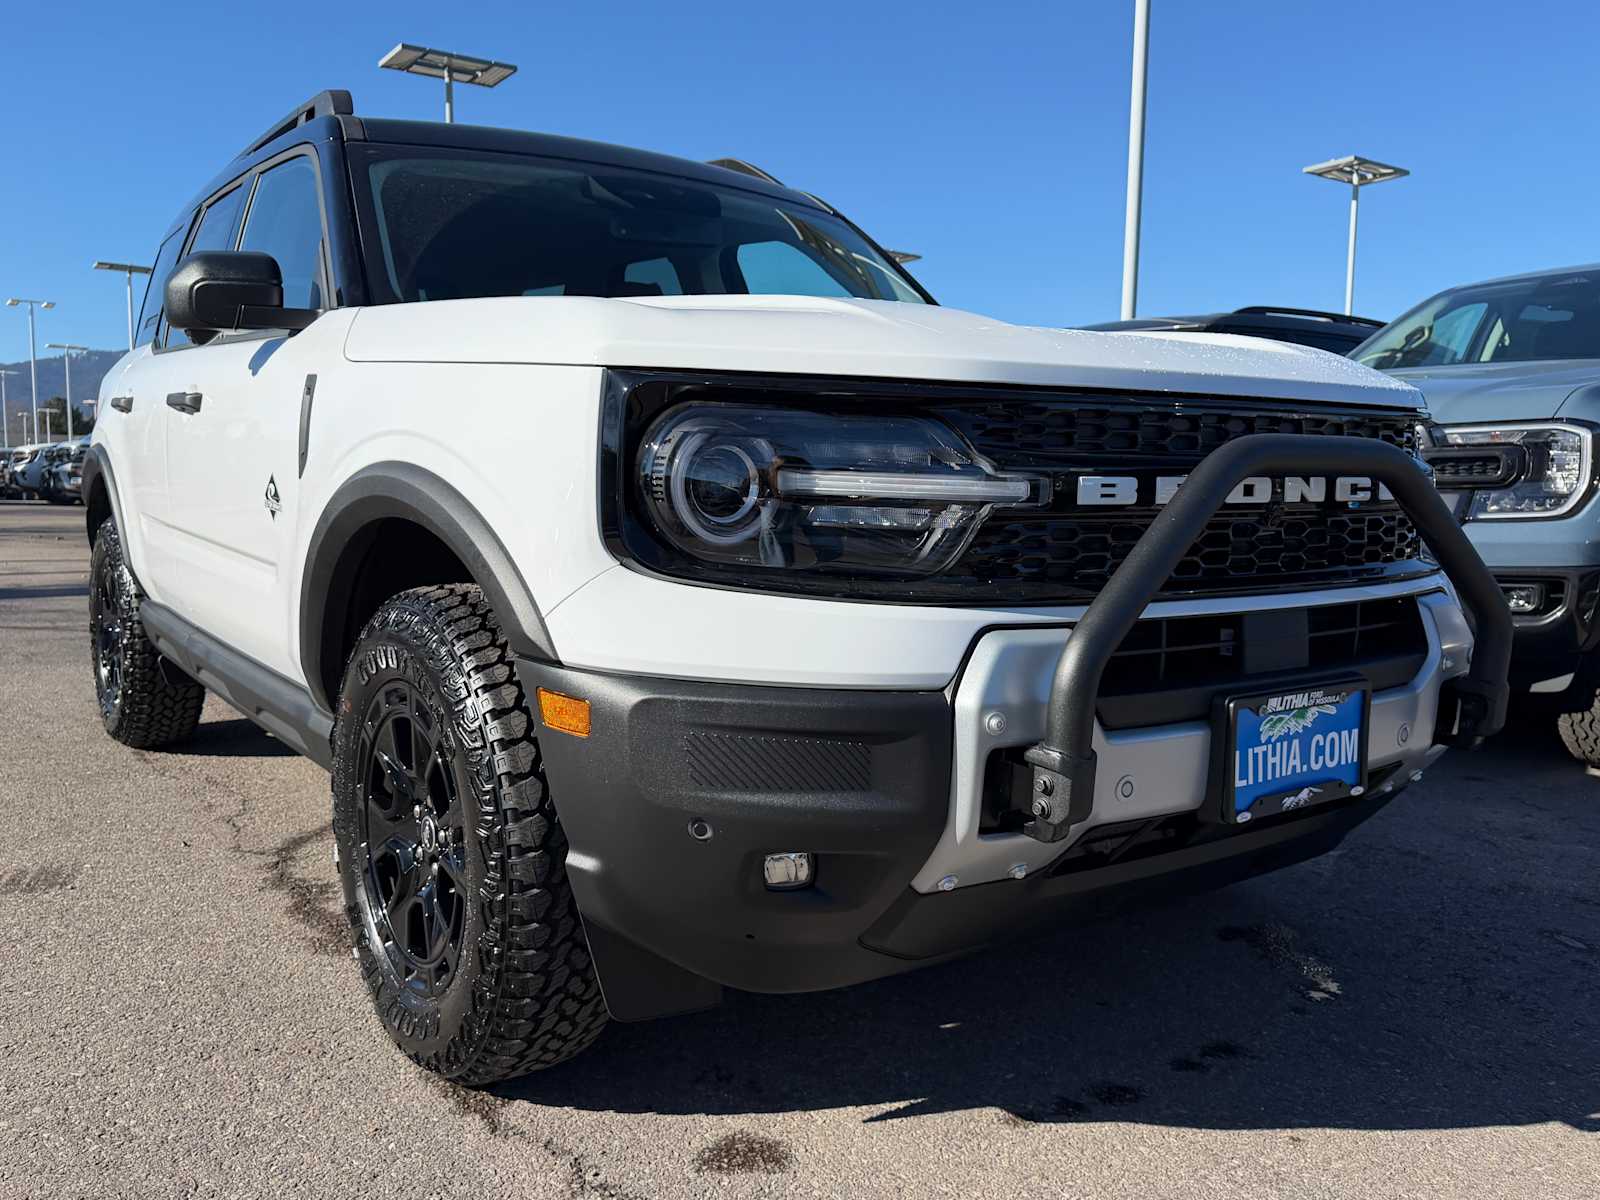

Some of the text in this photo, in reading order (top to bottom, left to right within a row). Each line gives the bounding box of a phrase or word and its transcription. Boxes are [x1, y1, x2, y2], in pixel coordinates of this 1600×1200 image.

[1077, 476, 1396, 505] BONC
[1275, 693, 1309, 711] LITHIA
[1235, 728, 1359, 787] LITHIA.COM
